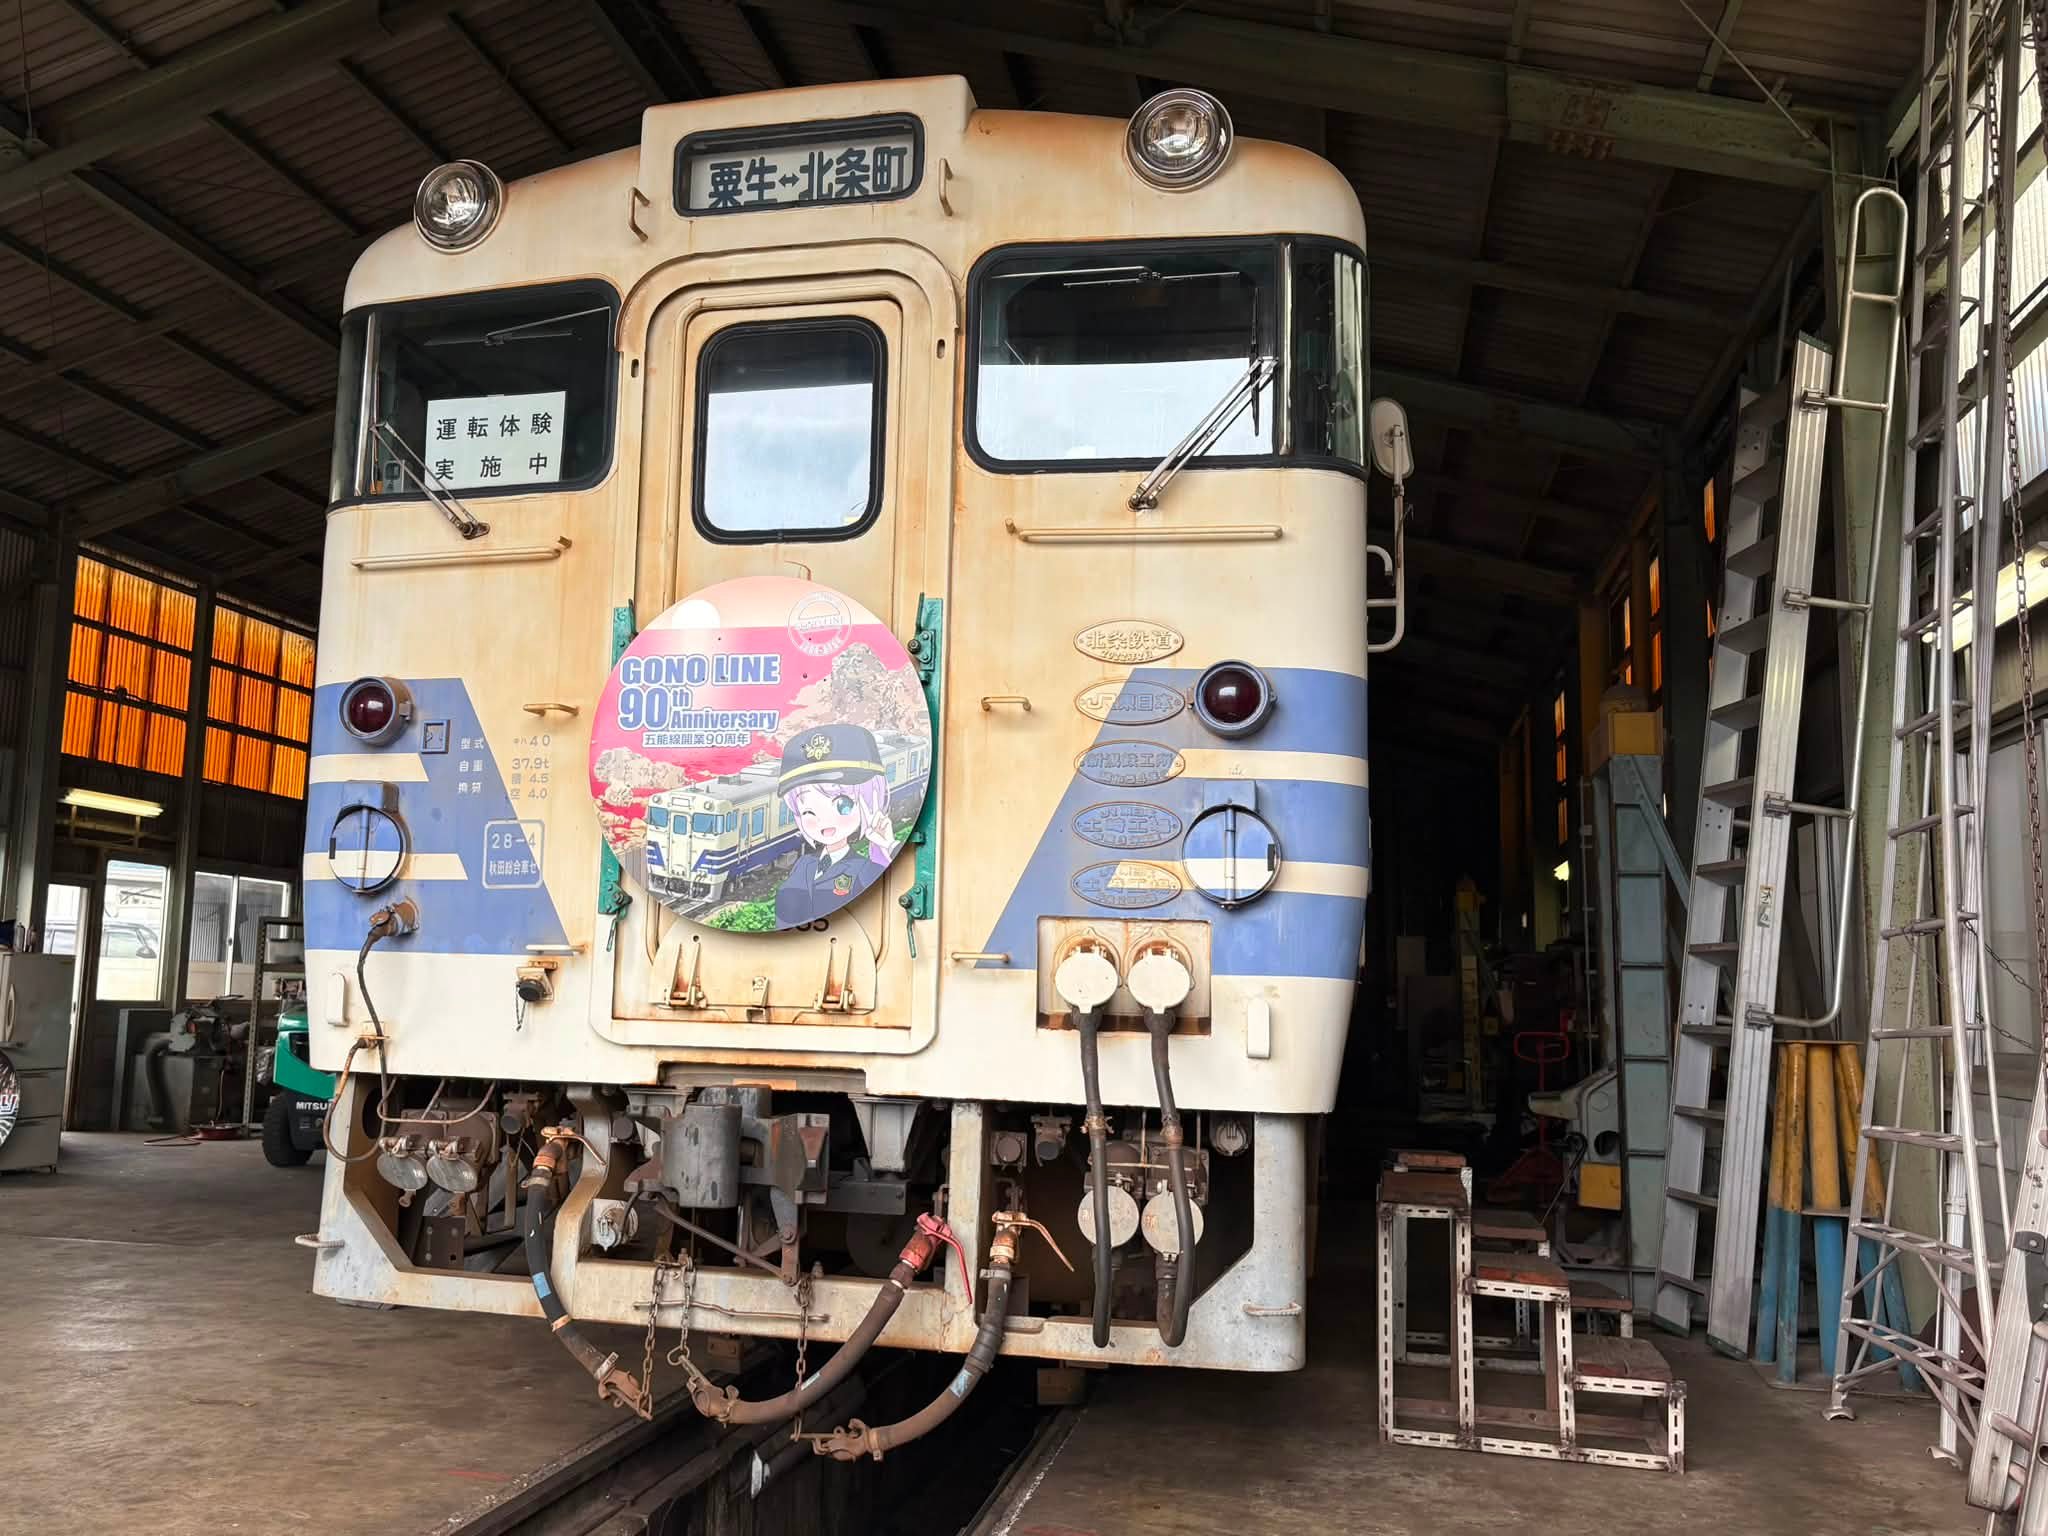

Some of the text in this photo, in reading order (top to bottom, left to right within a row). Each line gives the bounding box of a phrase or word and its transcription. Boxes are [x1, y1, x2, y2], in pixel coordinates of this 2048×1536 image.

[798, 146, 908, 201] 北条町
[436, 411, 553, 441] 運転体験
[435, 452, 548, 481] 実施中
[1087, 631, 1172, 650] 北条鉄道
[620, 654, 781, 686] GONO LINE
[670, 709, 778, 731] Anniversary
[644, 732, 750, 747] 五能線開業90周年
